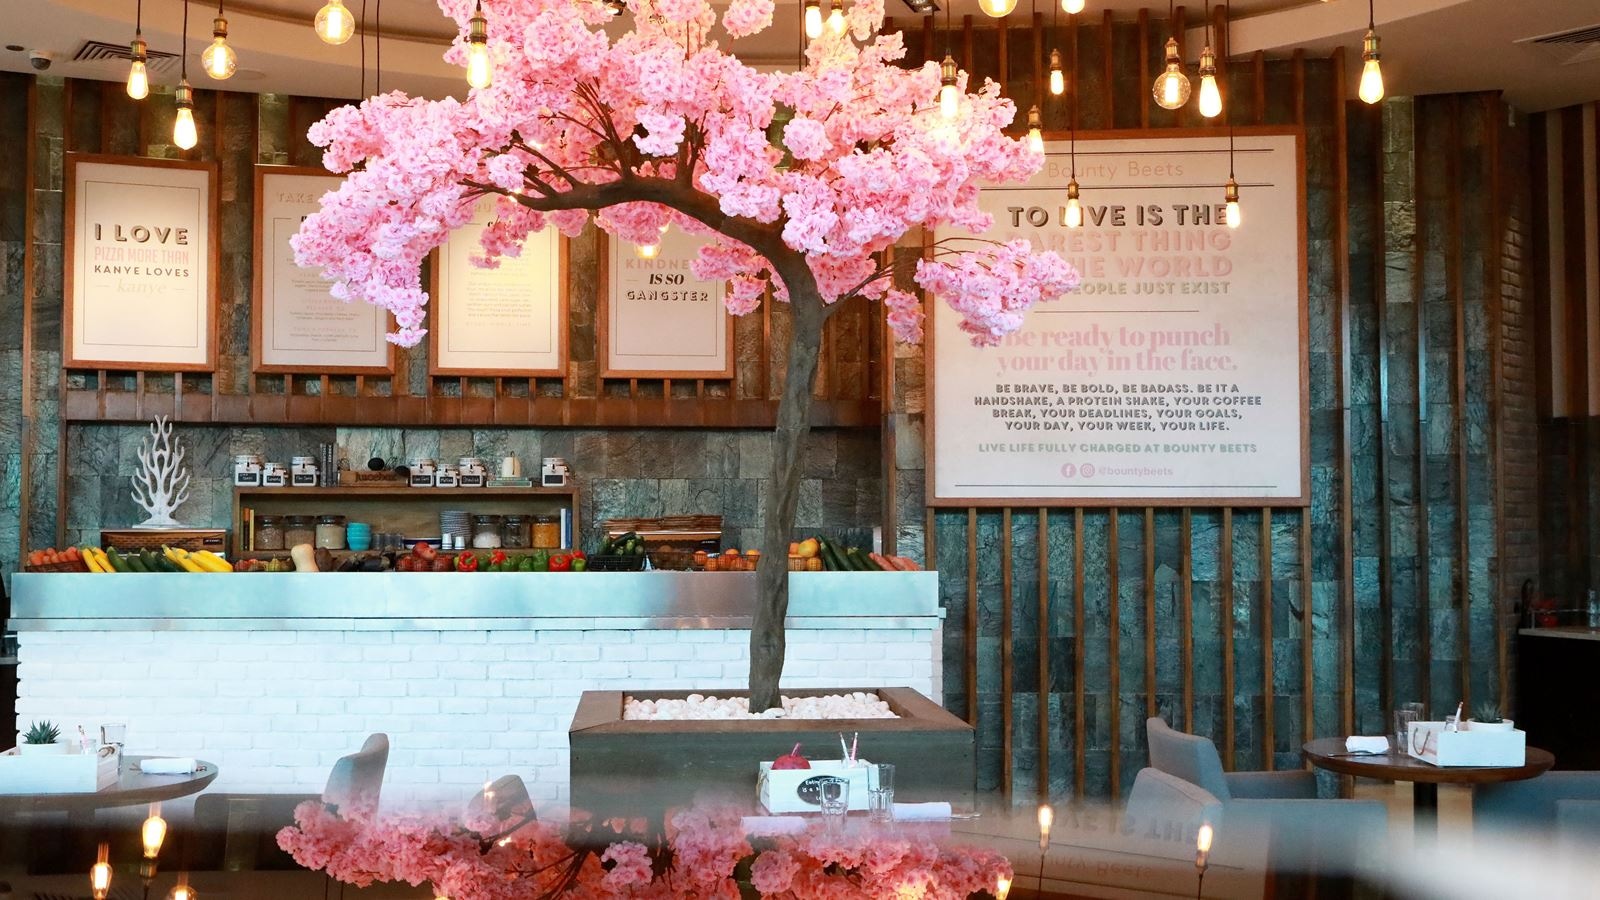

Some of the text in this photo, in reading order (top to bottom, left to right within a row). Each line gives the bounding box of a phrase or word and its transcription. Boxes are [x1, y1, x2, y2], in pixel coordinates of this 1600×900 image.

[1048, 160, 1184, 181] Bounty Beets
[1007, 206, 1049, 228] TO
[1136, 204, 1164, 227] IS
[1172, 204, 1229, 226] THE
[94, 223, 188, 246] I LOVE
[1131, 229, 1232, 252] THING
[94, 246, 189, 265] PIZZA MORE THAN
[94, 265, 189, 278] KANYE LOVES
[625, 258, 689, 271] KINDNE
[1118, 255, 1233, 278] WORLD
[649, 273, 685, 286] IS SO
[116, 278, 167, 298] kanye
[1132, 282, 1177, 296] JUST
[1180, 281, 1232, 295] EXIST
[627, 290, 709, 302] GANGSTER
[1004, 323, 1232, 354] Be ready to punch
[996, 347, 1239, 377] your day in the face.
[996, 384, 1240, 395] BE BRAVE, BE BOLD, BE BADASS. BE IT A
[974, 396, 1262, 407] HANDSHAKE, A PROTEIN SHAKE, YOUR COFFEE
[992, 409, 1243, 420] BREAK, YOUR DEADLINES, YOUR GOALS,
[1005, 421, 1230, 432] YOUR DAY, YOUR WEEK, YOUR LIFE.
[978, 443, 1257, 453] LIVE LIFE FULLY CHARGED AT BOUNTY BEETS
[1098, 466, 1174, 478] @bountybeets
